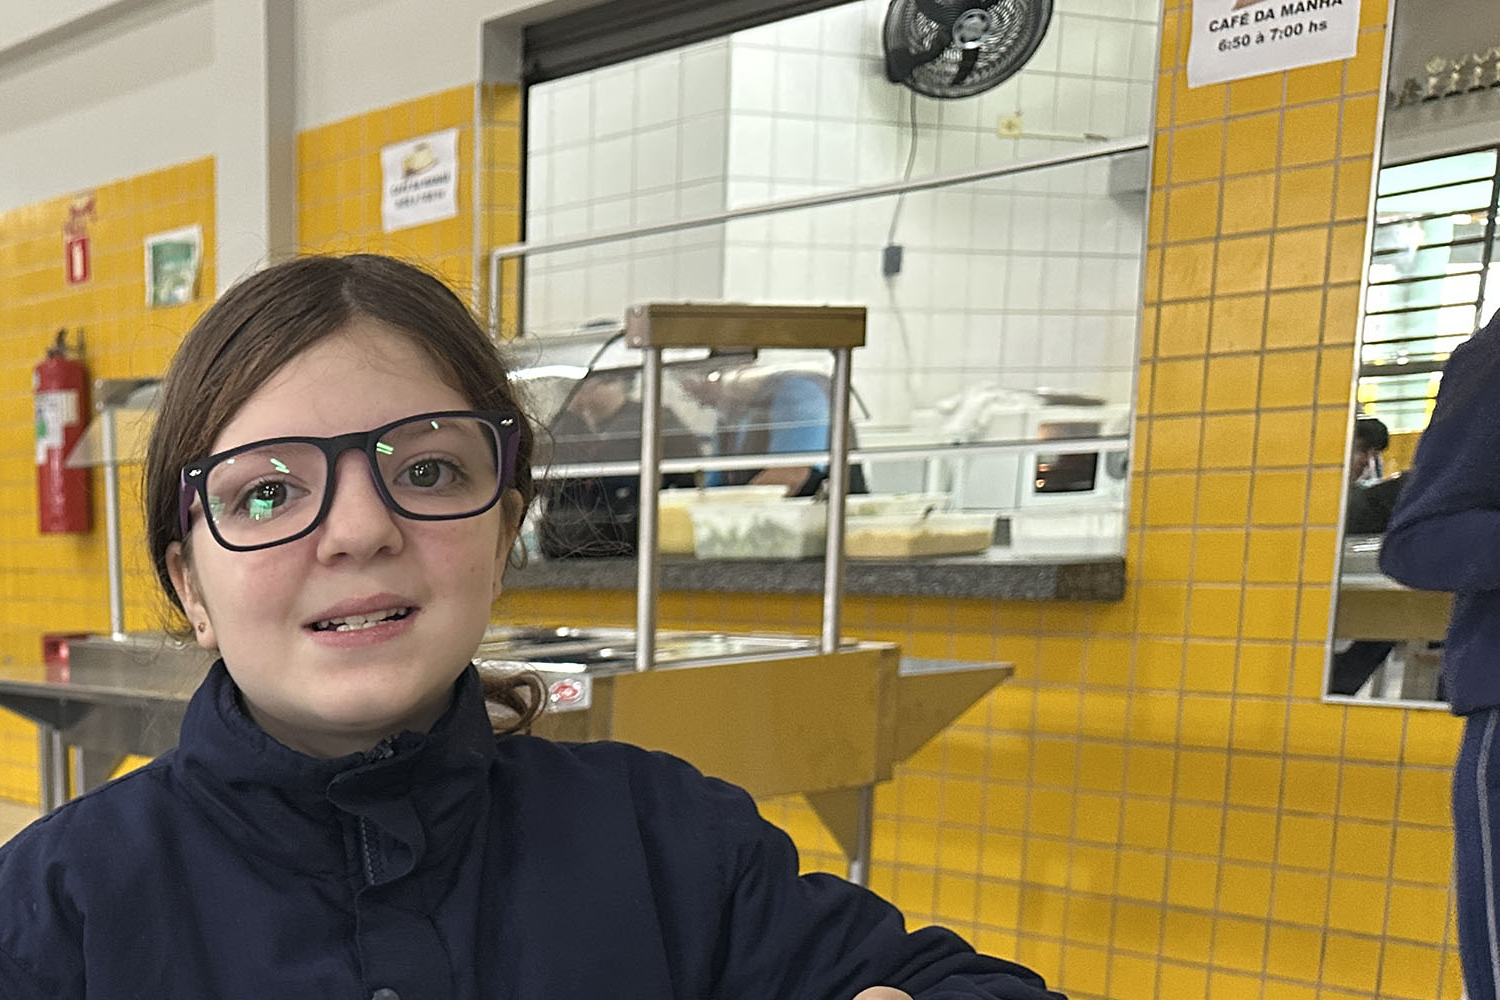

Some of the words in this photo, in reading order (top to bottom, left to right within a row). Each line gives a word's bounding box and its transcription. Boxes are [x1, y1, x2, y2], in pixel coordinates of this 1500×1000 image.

[1209, 13, 1250, 32] CAFÉ
[1254, 9, 1275, 23] DA
[1218, 34, 1251, 52] 6:50
[1270, 23, 1304, 41] 7:00
[1308, 20, 1328, 33] hs
